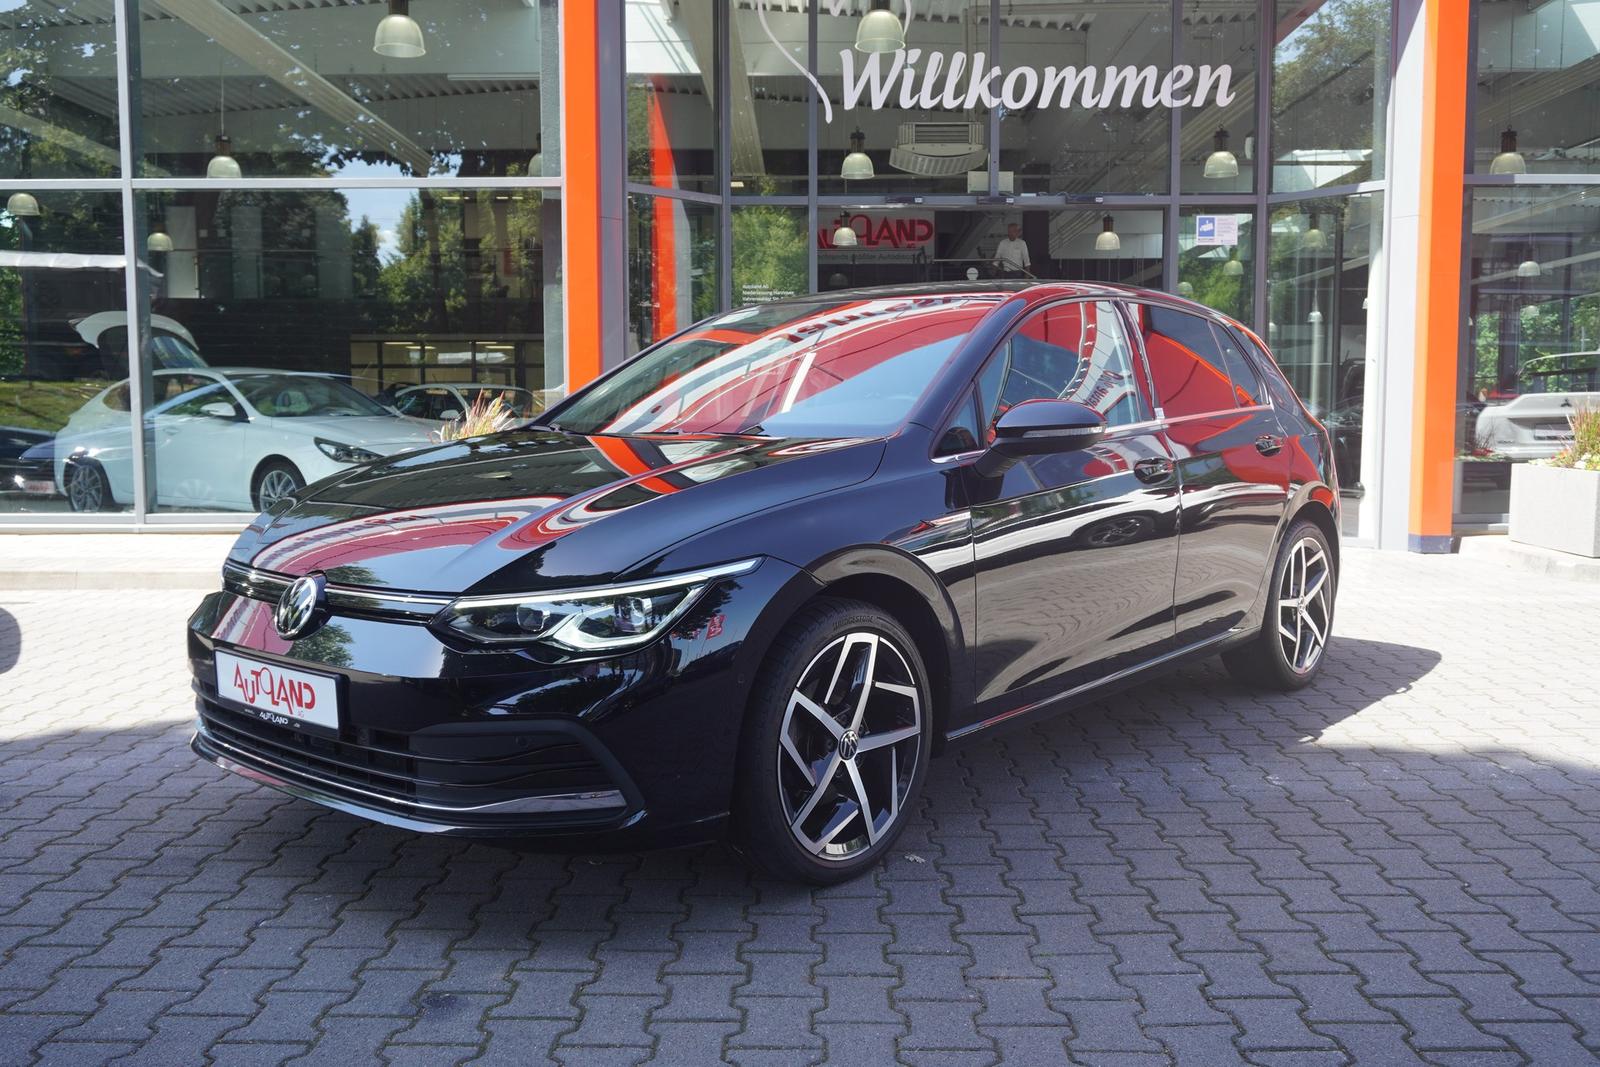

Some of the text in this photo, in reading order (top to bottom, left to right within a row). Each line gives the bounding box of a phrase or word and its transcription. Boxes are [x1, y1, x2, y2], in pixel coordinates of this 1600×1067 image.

[839, 49, 1236, 111] Willkommen
[817, 214, 934, 249] UOLAND
[234, 663, 316, 715] AUTOLAND
[260, 711, 288, 725] AUTOLAND
